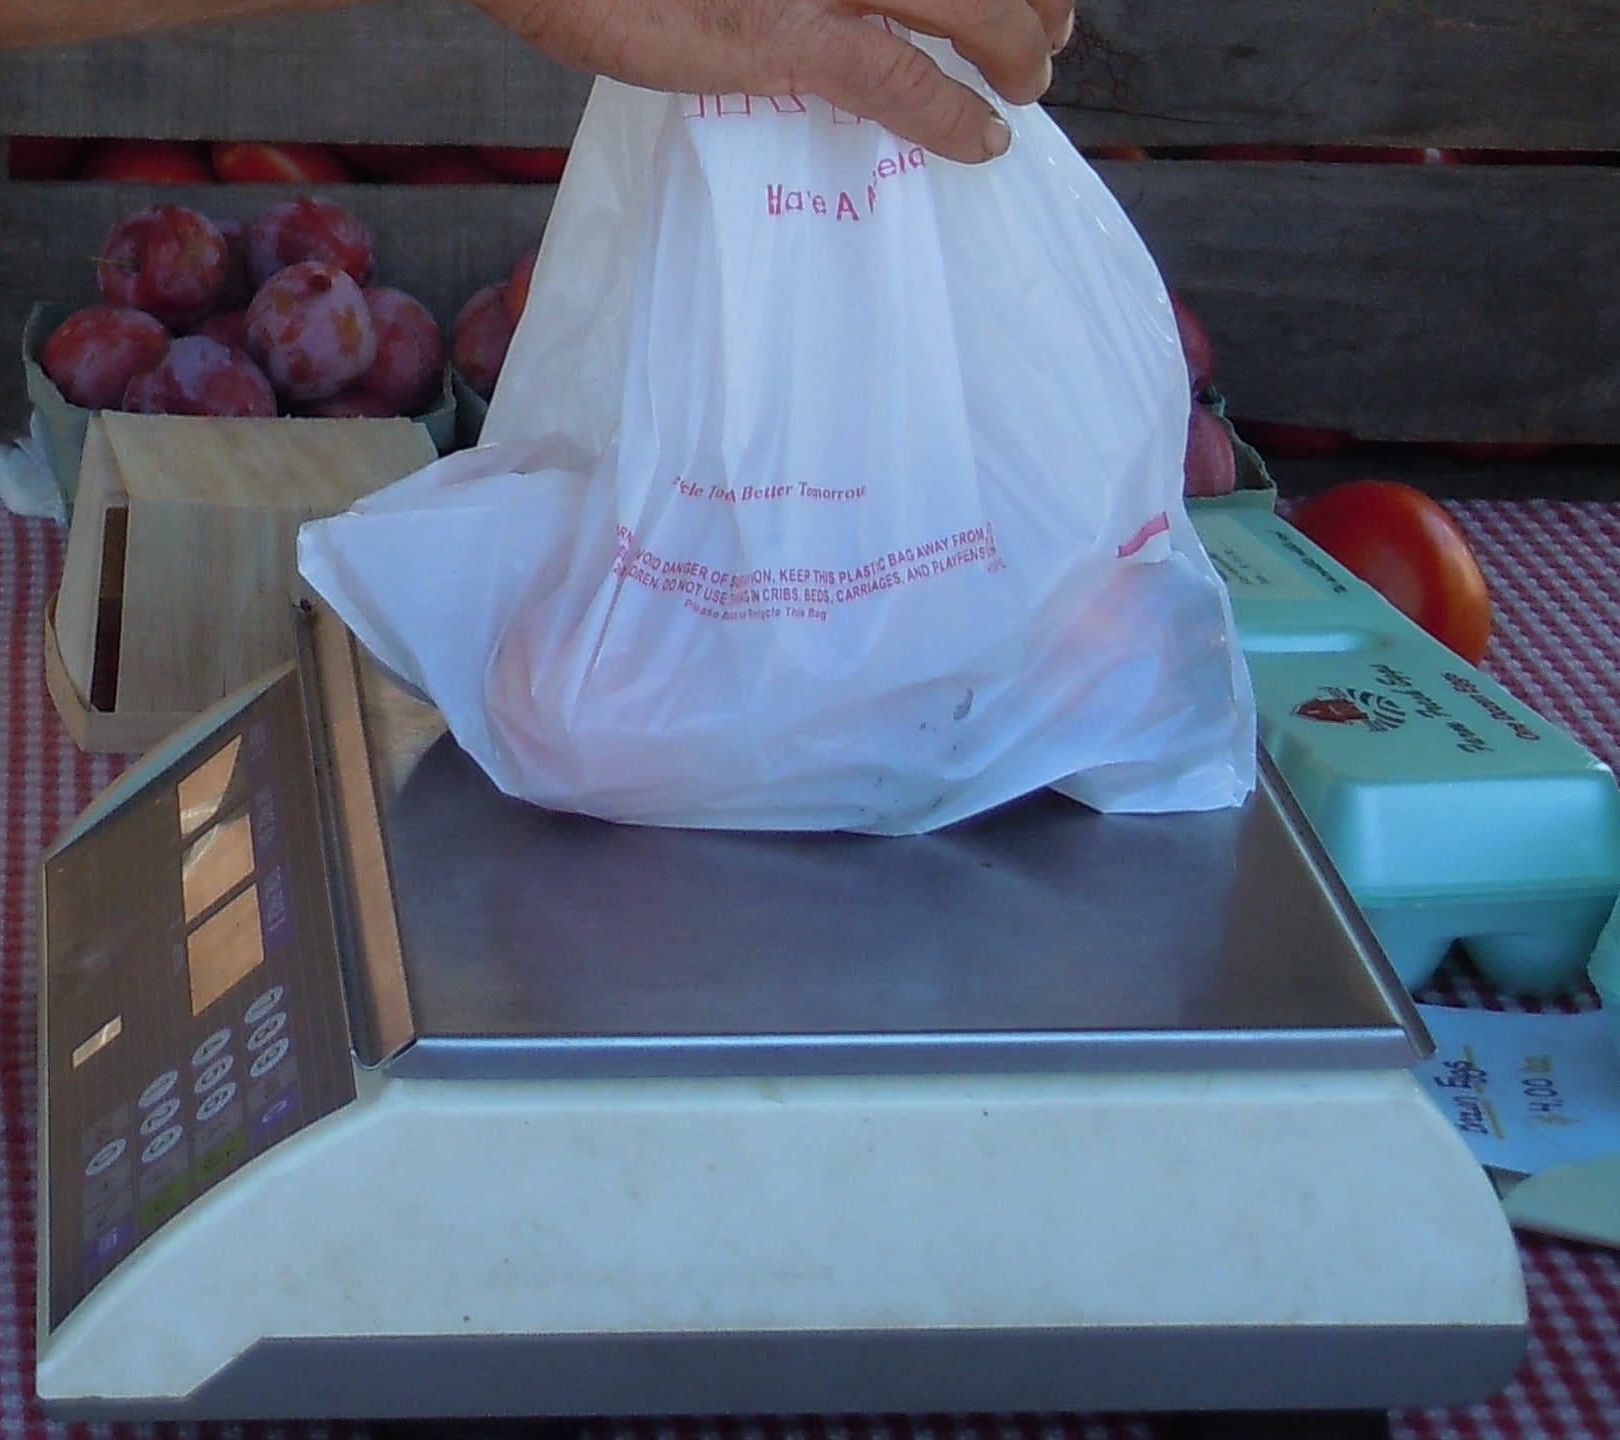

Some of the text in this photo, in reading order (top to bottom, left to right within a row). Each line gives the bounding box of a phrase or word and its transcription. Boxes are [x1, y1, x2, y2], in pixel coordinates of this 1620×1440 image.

[836, 191, 860, 221] A
[741, 484, 793, 501] Better
[662, 561, 708, 580] DANGER
[711, 570, 729, 586] OF
[780, 568, 811, 583] KEEP
[813, 569, 836, 585] THIS
[839, 557, 886, 585] PLASTIC
[887, 548, 915, 567] BAG
[916, 537, 948, 559] AWAY
[677, 579, 702, 596] NOT
[704, 587, 728, 605] USE
[907, 563, 931, 581] AND
[785, 606, 805, 618] This
[807, 607, 827, 622] Bag
